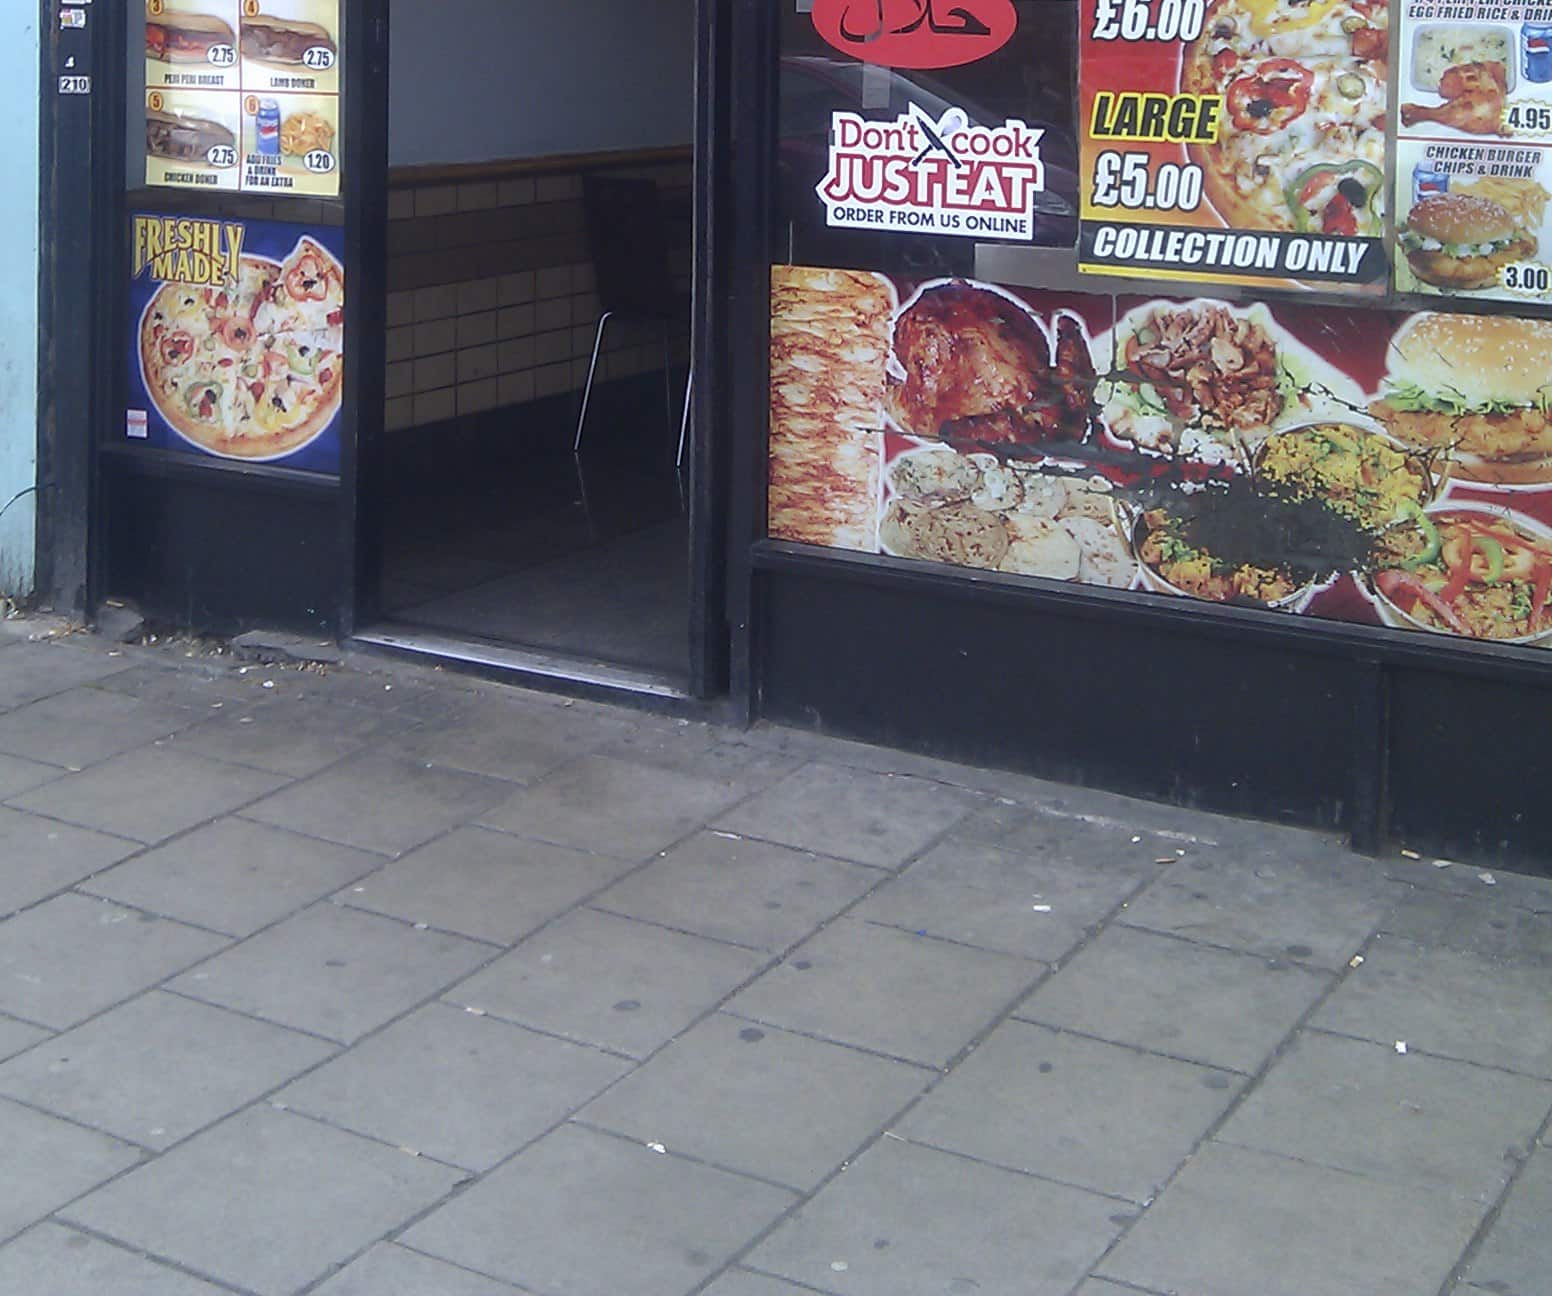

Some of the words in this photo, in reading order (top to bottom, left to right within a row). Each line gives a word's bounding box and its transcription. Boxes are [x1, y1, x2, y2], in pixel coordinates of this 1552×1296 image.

[1409, 6, 1434, 18] EGG
[1437, 6, 1474, 19] FRIED
[1477, 7, 1508, 20] RICE
[212, 48, 234, 64] 2.75
[307, 50, 330, 67] 2.75
[61, 78, 87, 91] 210
[1090, 93, 1221, 144] LARGE
[1508, 107, 1551, 130] 4.95
[839, 118, 920, 153] Don't
[950, 127, 1034, 159] cook
[212, 149, 234, 165] 2.75
[308, 153, 330, 169] 1.20
[1426, 145, 1485, 162] CHICKEN
[1488, 149, 1542, 164] BURGER
[164, 172, 194, 184] CHICKEN
[1092, 151, 1206, 211] £5.00
[1433, 161, 1475, 176] CHIPS
[1490, 164, 1533, 178] DRINK
[826, 156, 938, 204] JUST
[946, 163, 1035, 209] EAT
[833, 206, 884, 224] ORDER
[889, 210, 936, 227] FROM
[940, 213, 960, 229] US
[965, 215, 1028, 234] ONLINE
[133, 215, 245, 284] FRESHLY
[1092, 226, 1281, 271] COLLECTION
[1284, 239, 1369, 275] ONLY
[152, 250, 226, 287] MADE
[1505, 266, 1549, 291] 3.00
